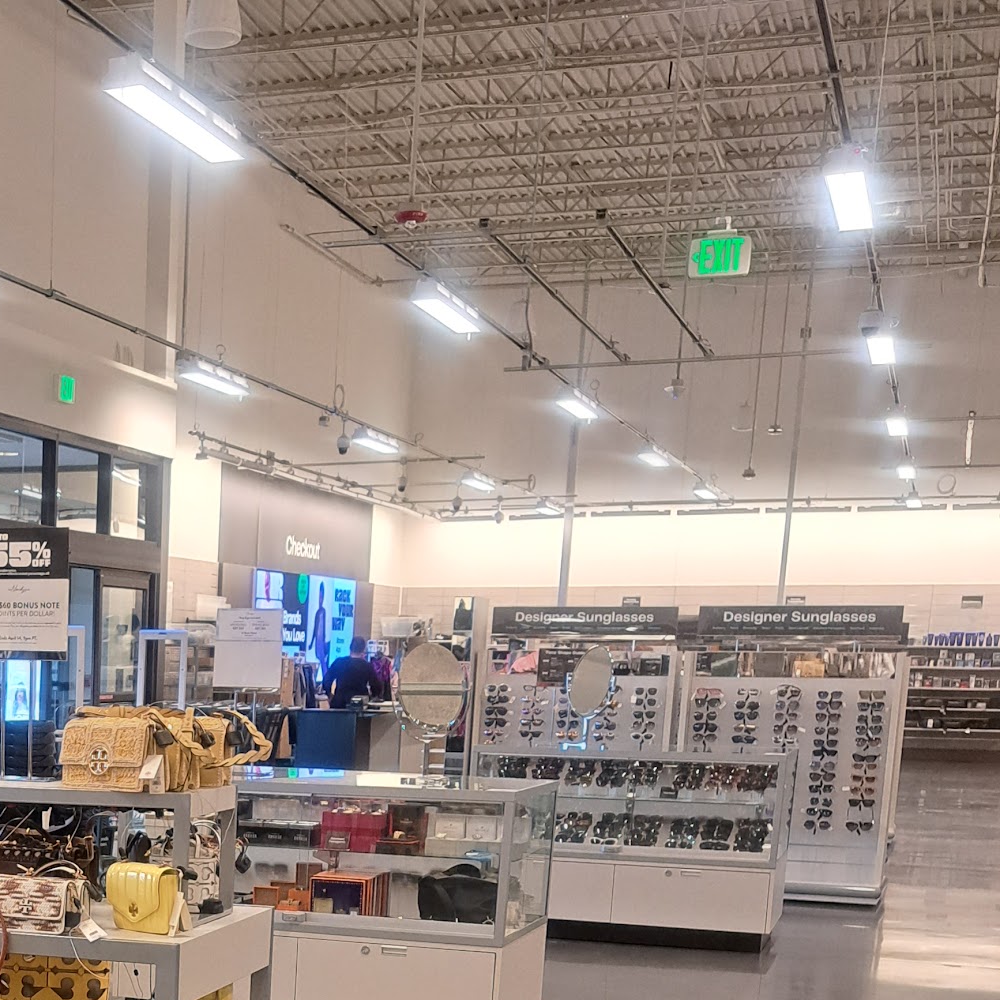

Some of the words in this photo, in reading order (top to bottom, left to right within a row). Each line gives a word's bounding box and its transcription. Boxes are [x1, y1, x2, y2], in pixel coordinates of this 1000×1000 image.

[698, 237, 744, 275] EXIT
[286, 535, 320, 560] Checkout
[32, 559, 50, 568] OFF
[283, 610, 302, 626] Brands
[515, 612, 574, 624] Designer
[577, 612, 654, 624] Sunglasses
[723, 611, 788, 624] Designer
[790, 611, 876, 624] Sunglasses
[282, 628, 293, 642] You
[293, 628, 306, 642] Love
